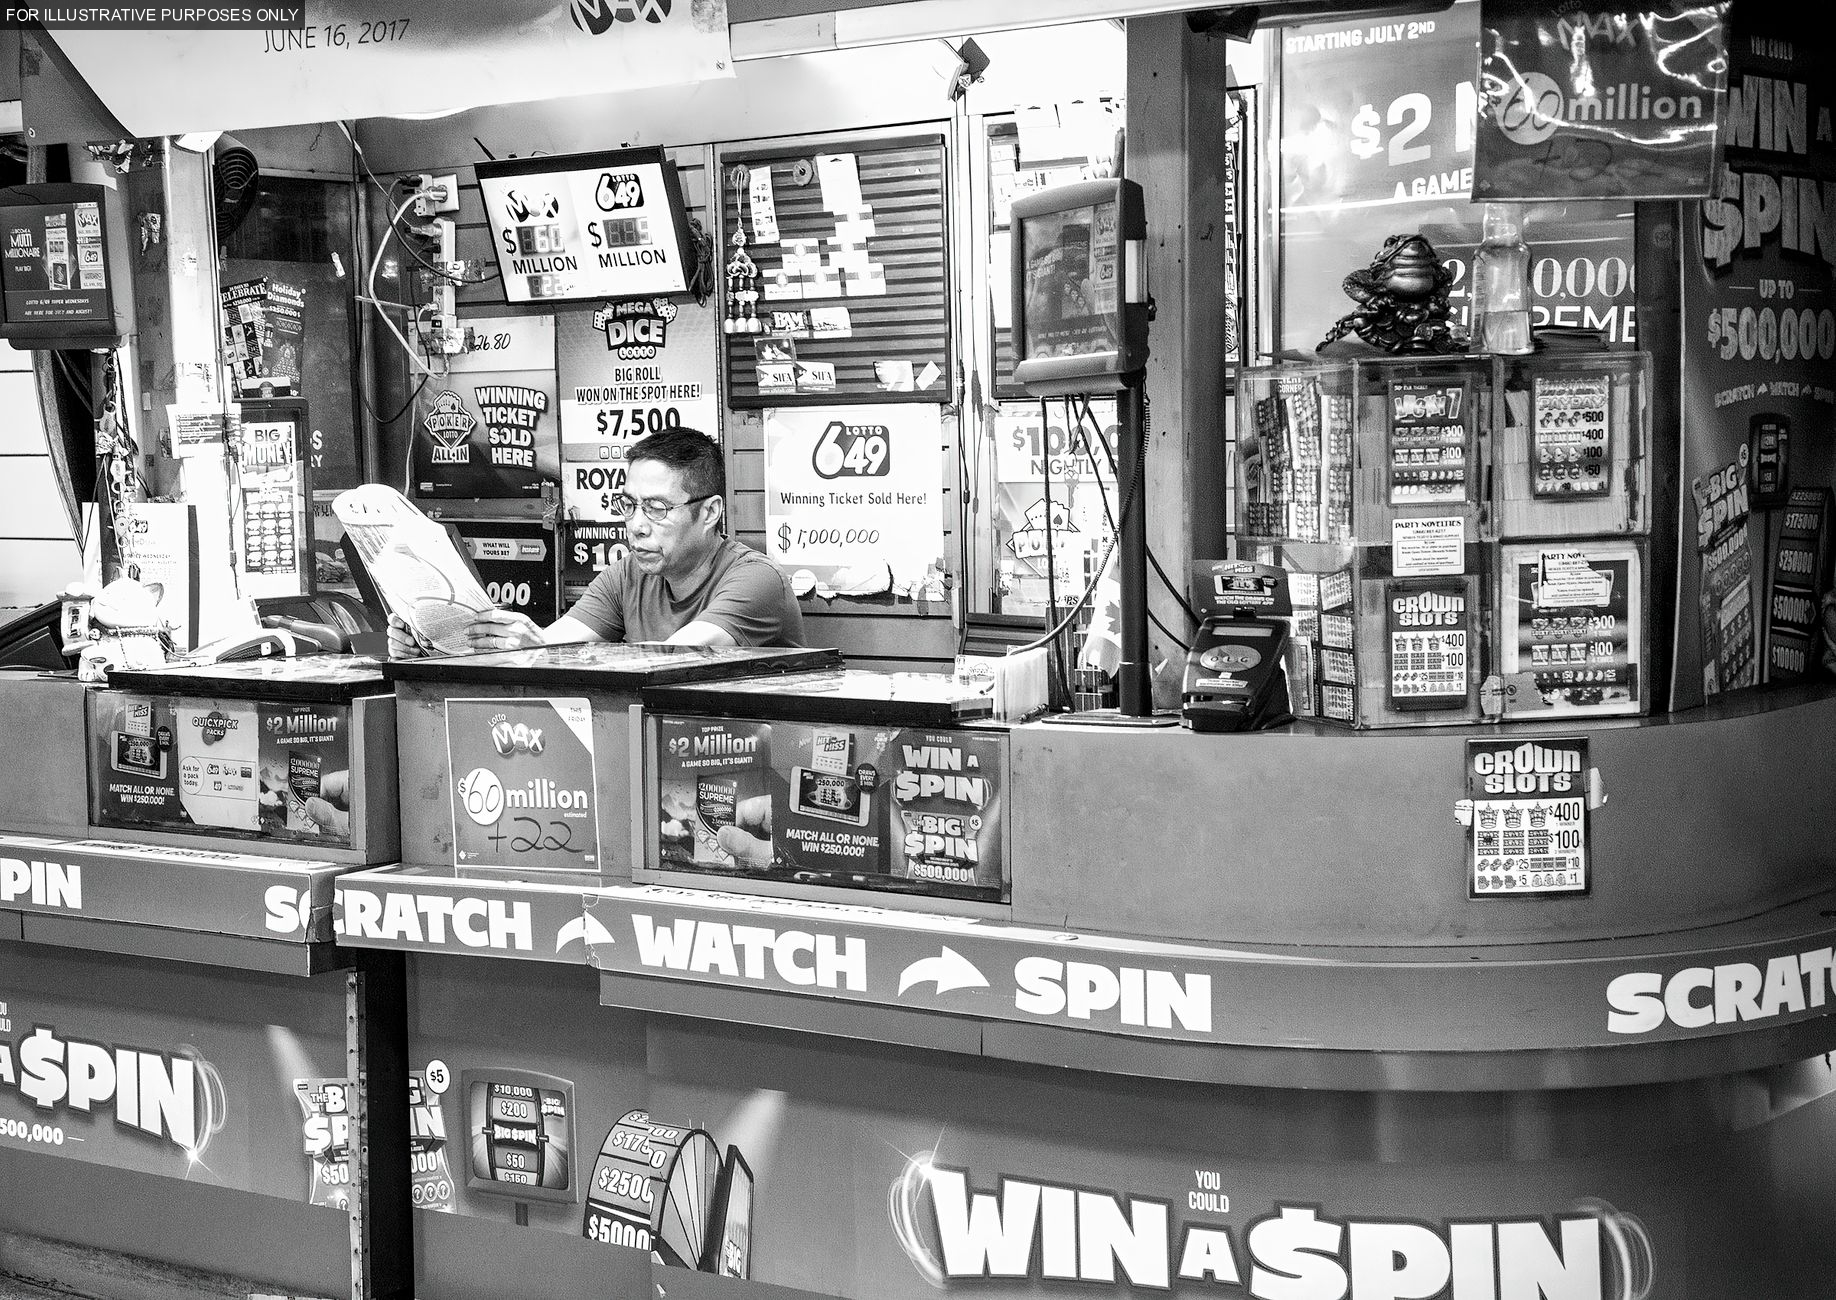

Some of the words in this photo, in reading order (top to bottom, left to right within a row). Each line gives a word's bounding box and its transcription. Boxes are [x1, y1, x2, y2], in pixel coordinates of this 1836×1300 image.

[324, 26, 351, 50] 16,
[357, 19, 411, 44] 2017
[1286, 29, 1362, 54] STARTING
[1364, 24, 1405, 45] JULY
[1407, 20, 1436, 40] 2ND
[1557, 12, 1640, 50] MAX
[1568, 83, 1702, 121] million
[1350, 92, 1432, 167] $2
[1411, 167, 1473, 198] GAME
[512, 255, 578, 275] MILLION
[598, 249, 667, 268] MILLION
[272, 283, 302, 300] Holiday
[1759, 278, 1777, 299] UP
[1777, 279, 1795, 300] TO
[267, 291, 305, 308] Diamonds
[615, 301, 655, 316] MEGA
[607, 319, 665, 347] DICE
[1707, 306, 1836, 365] $500,000
[620, 346, 655, 358] LOTTO
[614, 367, 633, 383] BIG
[635, 366, 661, 381] ROLL
[475, 386, 547, 411] WINNING
[576, 388, 600, 403] WON
[602, 388, 617, 401] ON
[620, 387, 639, 401] THE
[641, 385, 667, 400] SPOT
[669, 384, 701, 399] HERE!
[431, 414, 469, 431] POKER
[482, 406, 537, 428] TICKET
[596, 407, 681, 440] $7,500
[254, 428, 281, 443] BIG
[443, 430, 459, 439] LOTTO
[488, 427, 532, 447] SOLD
[845, 425, 883, 436] LOTTO
[491, 446, 534, 468] HERE
[1709, 463, 1737, 503] BIG
[780, 492, 825, 508] Winning
[829, 492, 863, 505] Ticket
[868, 492, 893, 505] Sold
[896, 492, 927, 505] Here!
[1395, 521, 1419, 529] PARTY
[1421, 520, 1462, 528] NOVELTIES
[1697, 484, 1749, 548] $PIN
[574, 526, 616, 540] WINNING
[797, 528, 880, 549] 1,000,000
[1392, 591, 1465, 614] CROWN
[1399, 611, 1459, 626] SLOTS
[266, 716, 284, 735] $2
[286, 713, 339, 734] Million
[487, 713, 507, 727] Lotto
[491, 722, 543, 754] MAX
[668, 736, 691, 758] $2
[693, 733, 759, 757] Million
[824, 740, 846, 752] MISS
[936, 735, 953, 744] COULD
[686, 760, 702, 768] GAME
[710, 759, 723, 767] BIG,
[902, 744, 962, 772] WIN
[966, 754, 979, 768] A
[1473, 742, 1582, 776] CROWN
[290, 765, 319, 778] SUPREME
[109, 783, 132, 794] MATCH
[132, 785, 145, 795] ALL
[144, 786, 155, 795] OR
[896, 770, 984, 807] $PIN
[1483, 772, 1573, 794] SLOTS
[120, 794, 134, 804] WIN
[133, 794, 165, 806] $250,000!
[506, 778, 589, 810] million
[698, 791, 735, 805] SUPREME
[563, 811, 588, 819] estimated
[1548, 801, 1581, 822] $400
[487, 816, 585, 854] +22
[921, 815, 963, 836] BIG
[785, 828, 819, 841] MATCH
[819, 832, 836, 843] ALL
[835, 833, 851, 844] OR
[904, 829, 979, 863] $PIN
[1548, 828, 1581, 850] $100
[801, 841, 820, 853] WIN
[820, 843, 866, 858] $250,000!
[913, 864, 969, 883] $500,000
[1515, 858, 1530, 871] $25
[1568, 856, 1581, 869] $10
[1518, 874, 1528, 886] $5
[1570, 872, 1579, 884] $1
[632, 913, 867, 992] WATCH
[1013, 955, 1213, 1034] SPIN
[429, 1068, 445, 1084] $5
[19, 1027, 196, 1151] $PIN
[310, 1092, 330, 1104] THE
[494, 1083, 533, 1098] $10,000
[500, 1101, 528, 1118] $200
[1194, 1169, 1221, 1191] YOU
[1188, 1191, 1230, 1214] COULD
[928, 1165, 1171, 1291] WIN
[1177, 1224, 1243, 1286] A
